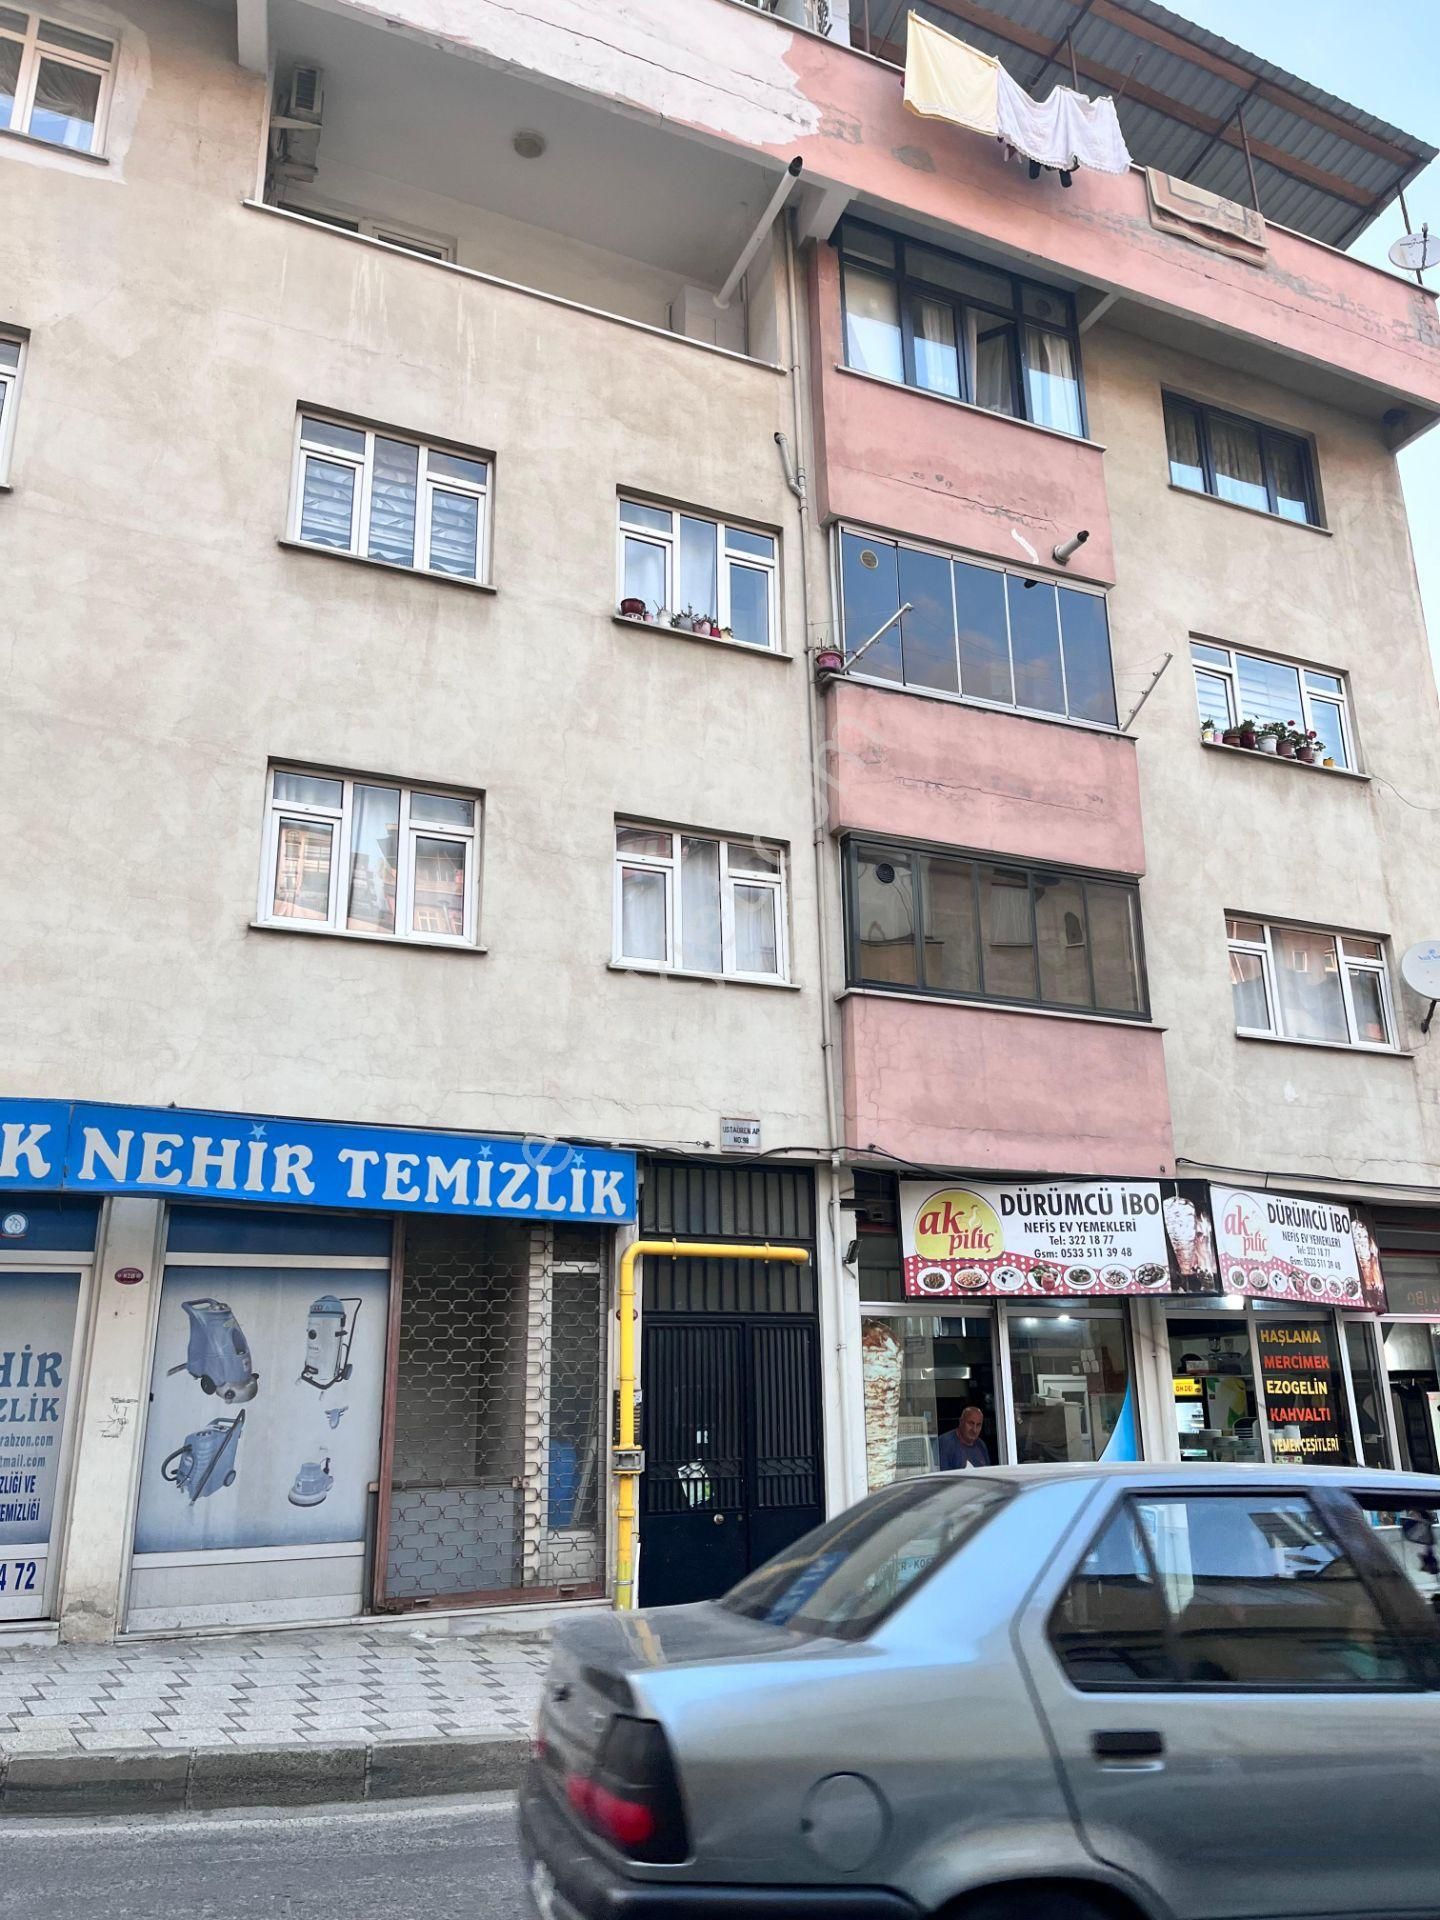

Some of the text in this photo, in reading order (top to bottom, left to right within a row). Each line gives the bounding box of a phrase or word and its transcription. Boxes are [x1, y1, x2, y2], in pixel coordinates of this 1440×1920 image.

[0, 1123, 51, 1179] K
[77, 1123, 316, 1196] NEHİR
[337, 1145, 627, 1216] TEMİZLİK
[1000, 1187, 1160, 1216] DÜRÜMCÜ İBO
[918, 1200, 966, 1235] ak
[1024, 1218, 1137, 1233] NEFİS EV YEMEKLERİ
[1224, 1204, 1250, 1236] ak
[1267, 1198, 1351, 1235] DÜRÜMCÜ İBO
[948, 1226, 995, 1256] piliç
[1049, 1234, 1114, 1246] Tel: 322 18 77
[1242, 1230, 1268, 1256] piliç
[1282, 1230, 1341, 1248] NEFİS EV YEMEKLERİ
[1034, 1247, 1132, 1259] Gsm: 0533 511 39 48
[1260, 1329, 1321, 1346] HAŞLAMA
[1263, 1352, 1330, 1369] MERCİMEK
[1266, 1377, 1328, 1395] EZOGELİN
[1270, 1407, 1331, 1422] KAHVALTI
[1272, 1434, 1339, 1455] YEMEK ÇEŞİTLERİ
[24, 1475, 36, 1493] VE
[0, 1498, 40, 1522] EMİZLİĞİ
[15, 1562, 36, 1590] 72
